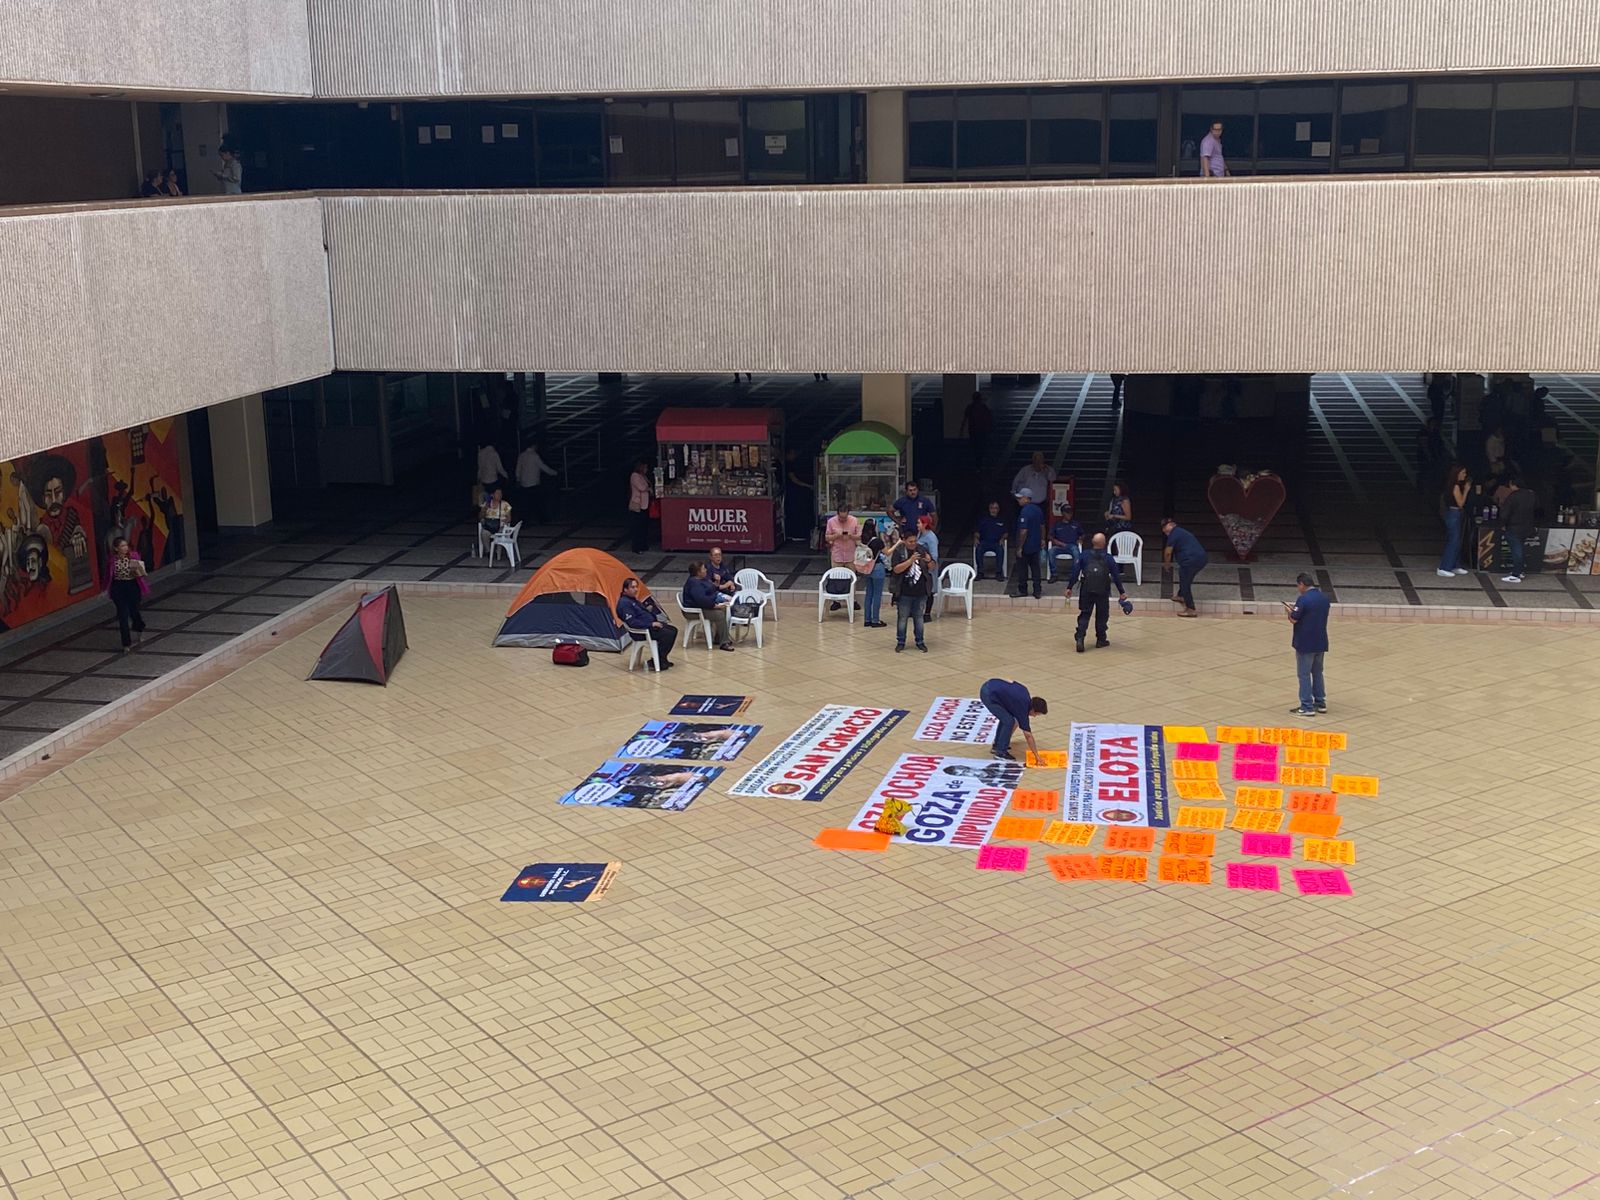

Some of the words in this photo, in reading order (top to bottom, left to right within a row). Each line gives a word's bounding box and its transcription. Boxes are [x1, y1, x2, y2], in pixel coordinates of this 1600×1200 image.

[689, 509, 748, 524] MUJER
[688, 523, 748, 532] PRODUCTIVA
[932, 698, 960, 720] OCHOA
[920, 721, 948, 740] LOZA
[956, 713, 980, 729] ESTA
[783, 753, 834, 780] SAN
[812, 708, 883, 752] IGNACIO
[949, 730, 970, 741] NO
[880, 756, 944, 799] OCHOA
[1098, 736, 1139, 802] ELOTA
[1069, 774, 1080, 800] PRESUPUESTO
[1083, 792, 1092, 802] PARA
[905, 790, 970, 843] GOZA
[945, 779, 963, 789] de
[950, 788, 1008, 846] IMPUNIDAD
[1067, 801, 1079, 821] EXIGIMOS
